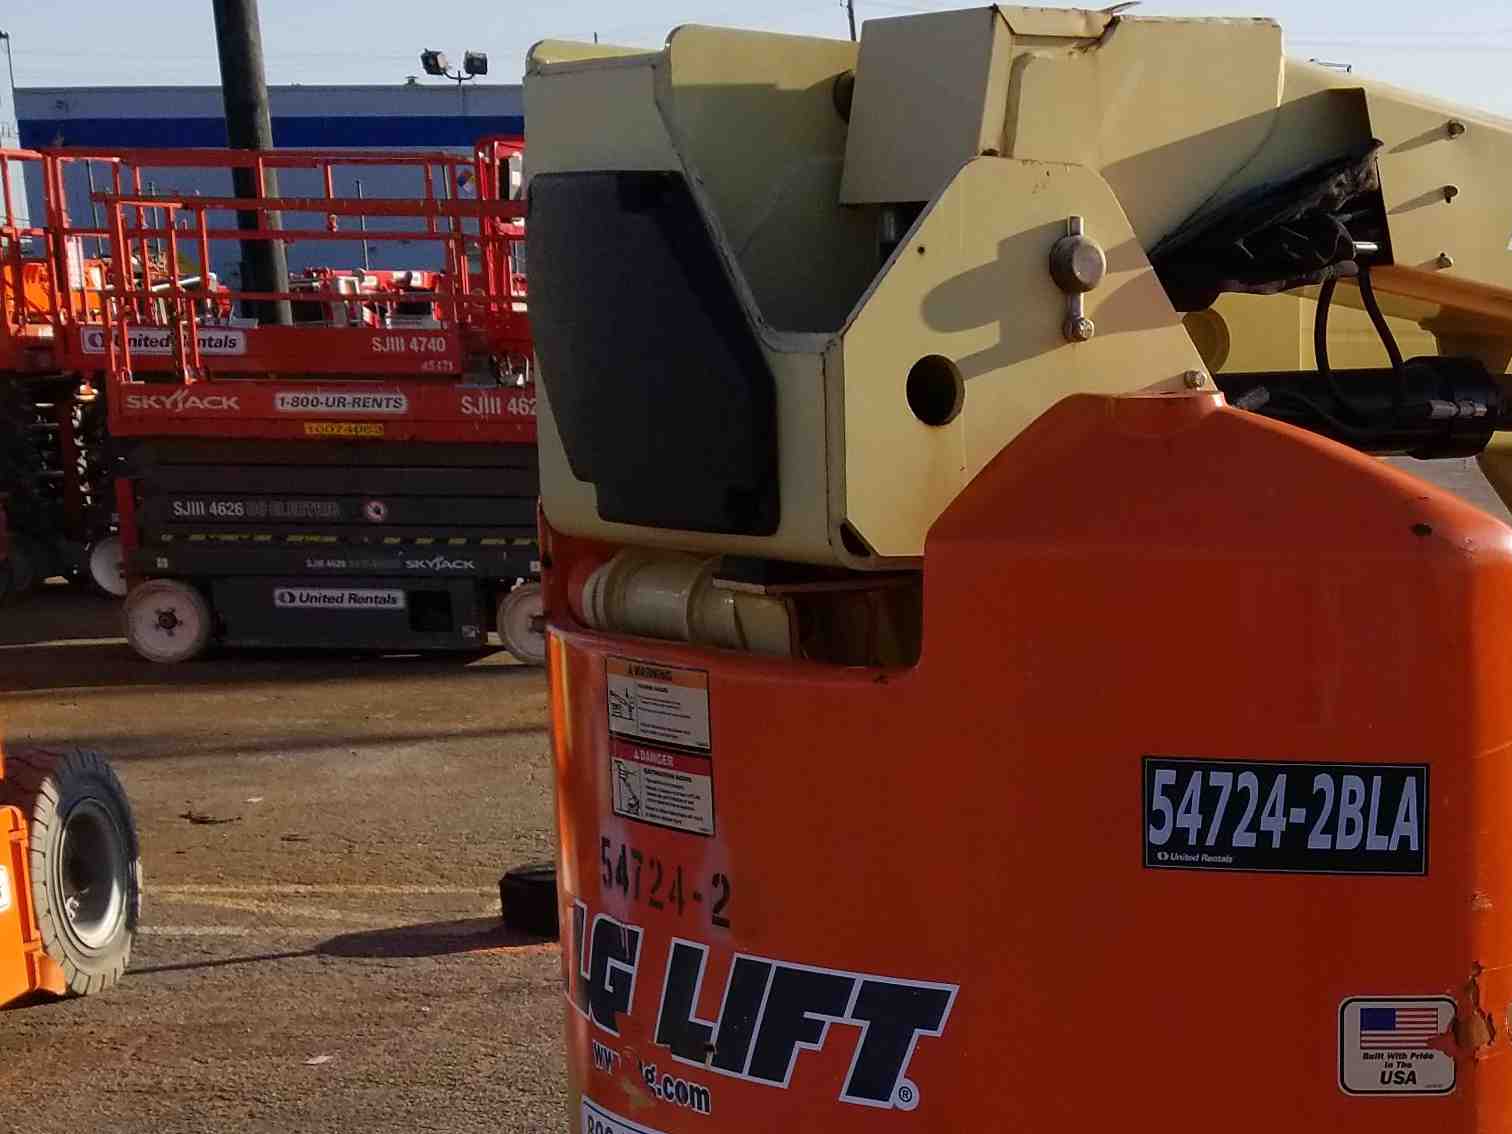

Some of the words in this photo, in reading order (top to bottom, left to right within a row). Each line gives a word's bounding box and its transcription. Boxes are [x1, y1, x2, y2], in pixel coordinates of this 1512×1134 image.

[410, 336, 446, 353] 4740
[126, 388, 241, 412] SKYJACK
[280, 393, 403, 410] 1-800-UR-RENTS
[508, 397, 537, 415] 462
[209, 501, 244, 517] 4626
[405, 555, 476, 571] SKYJACK
[299, 591, 345, 607] United
[348, 592, 398, 607] Rentals
[1149, 769, 1418, 851] 54724-2BLA
[1170, 851, 1199, 863] United
[1201, 853, 1233, 864] Rentals
[600, 836, 731, 929] 54724-2
[565, 898, 644, 1038] LG
[655, 937, 960, 1109] LIFT
[1362, 1052, 1385, 1060] Built
[1410, 1052, 1435, 1060] Pride
[1380, 1070, 1417, 1085] USA
